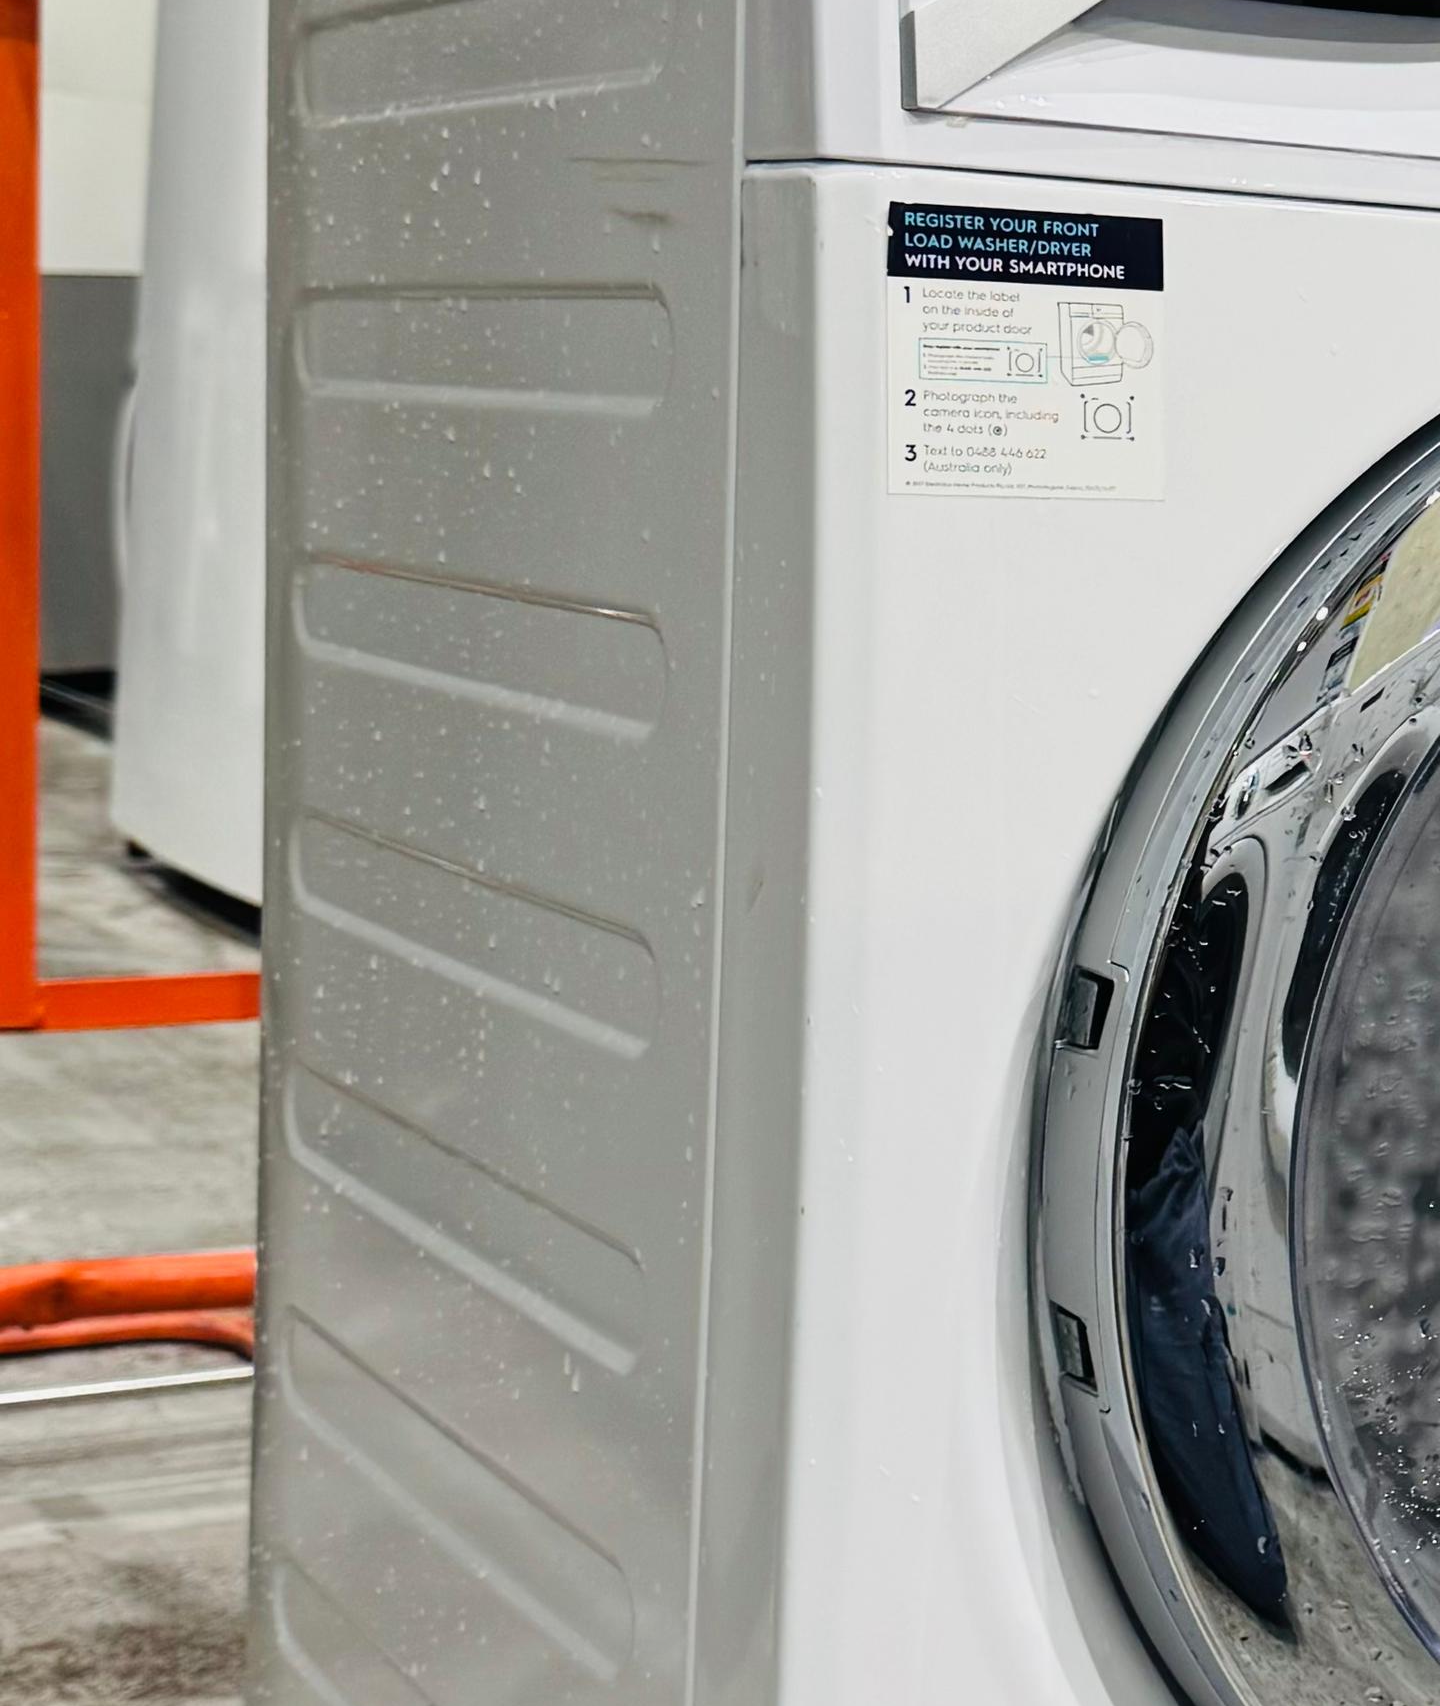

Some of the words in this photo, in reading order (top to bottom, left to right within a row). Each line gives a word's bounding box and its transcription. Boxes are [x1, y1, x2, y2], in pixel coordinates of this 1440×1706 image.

[905, 211, 984, 231] REGISTER
[990, 217, 1037, 234] YOUR
[1043, 221, 1099, 237] FRONT
[905, 232, 953, 249] LOAD
[958, 236, 1092, 257] WASHER/DRYER
[905, 253, 950, 270] WITH
[955, 256, 1003, 273] YOUR
[1009, 259, 1125, 280] SMARTPHONE
[904, 286, 911, 303] 1
[922, 287, 964, 301] Locate
[967, 288, 987, 301] the
[989, 289, 1020, 302] label
[922, 304, 938, 315] on
[942, 304, 961, 316] the
[964, 305, 999, 318] inside
[1002, 306, 1013, 318] of
[922, 321, 949, 335] your
[952, 321, 1000, 336] product
[1004, 323, 1032, 335] door
[904, 389, 917, 406] 2
[923, 390, 995, 407] Photograph
[999, 391, 1018, 404] the
[923, 407, 970, 418] camera
[1005, 409, 1059, 424] including
[923, 423, 942, 433] the
[946, 423, 954, 433] 4
[957, 423, 984, 435] dots
[904, 444, 917, 462] 3
[924, 444, 948, 457] Text
[951, 445, 963, 457] to
[1026, 448, 1047, 459] 622
[923, 461, 980, 474] (Australia
[984, 463, 1013, 476] only)
